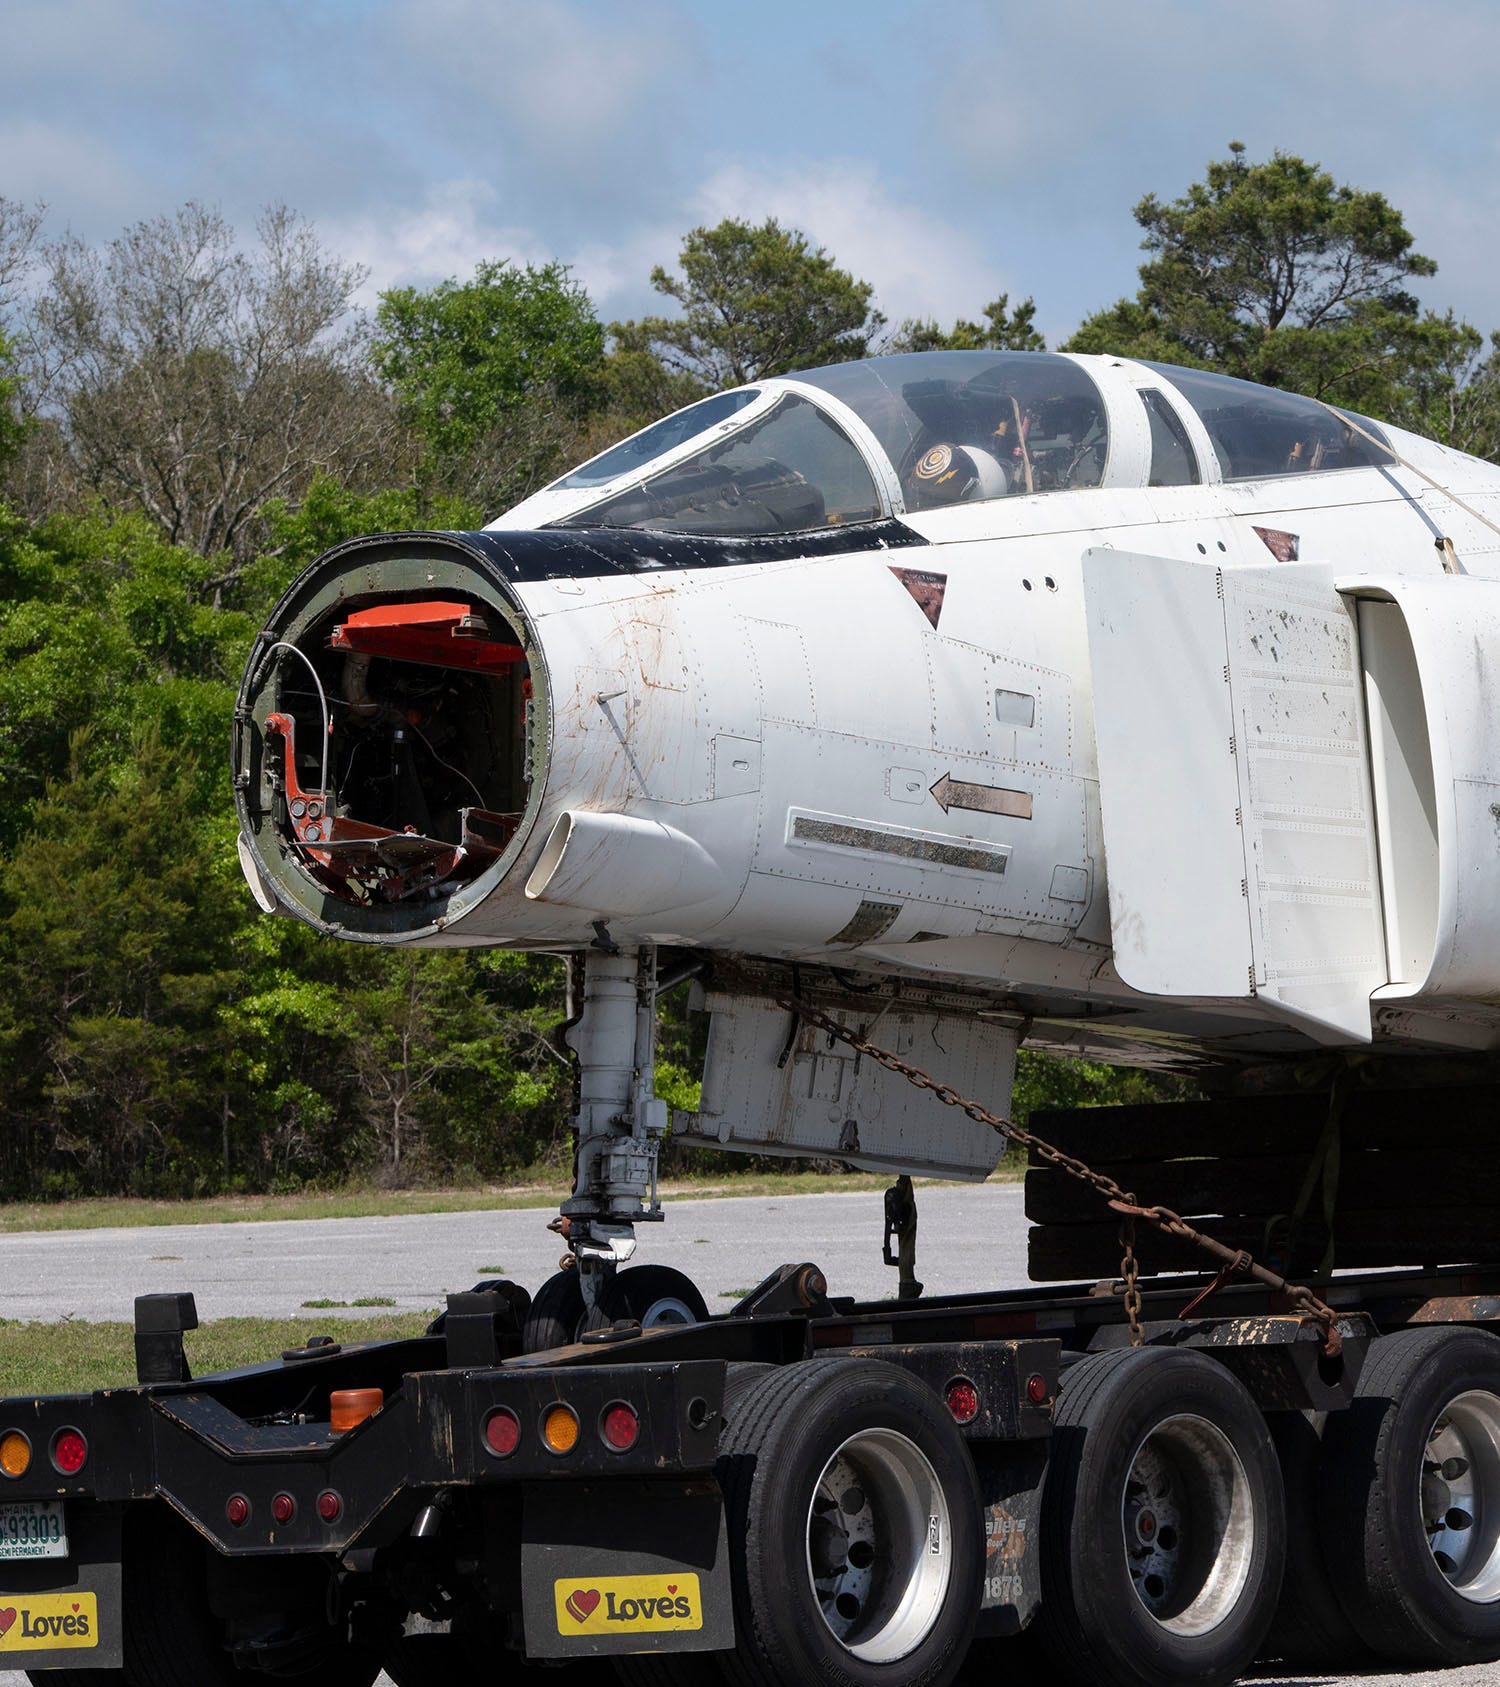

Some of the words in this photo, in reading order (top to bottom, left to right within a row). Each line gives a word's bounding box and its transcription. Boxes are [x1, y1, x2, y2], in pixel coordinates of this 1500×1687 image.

[9, 1514, 60, 1545] 93303
[985, 1517, 1027, 1535] ailers
[12, 1546, 46, 1557] PERMANENT
[984, 1575, 1024, 1599] 1878
